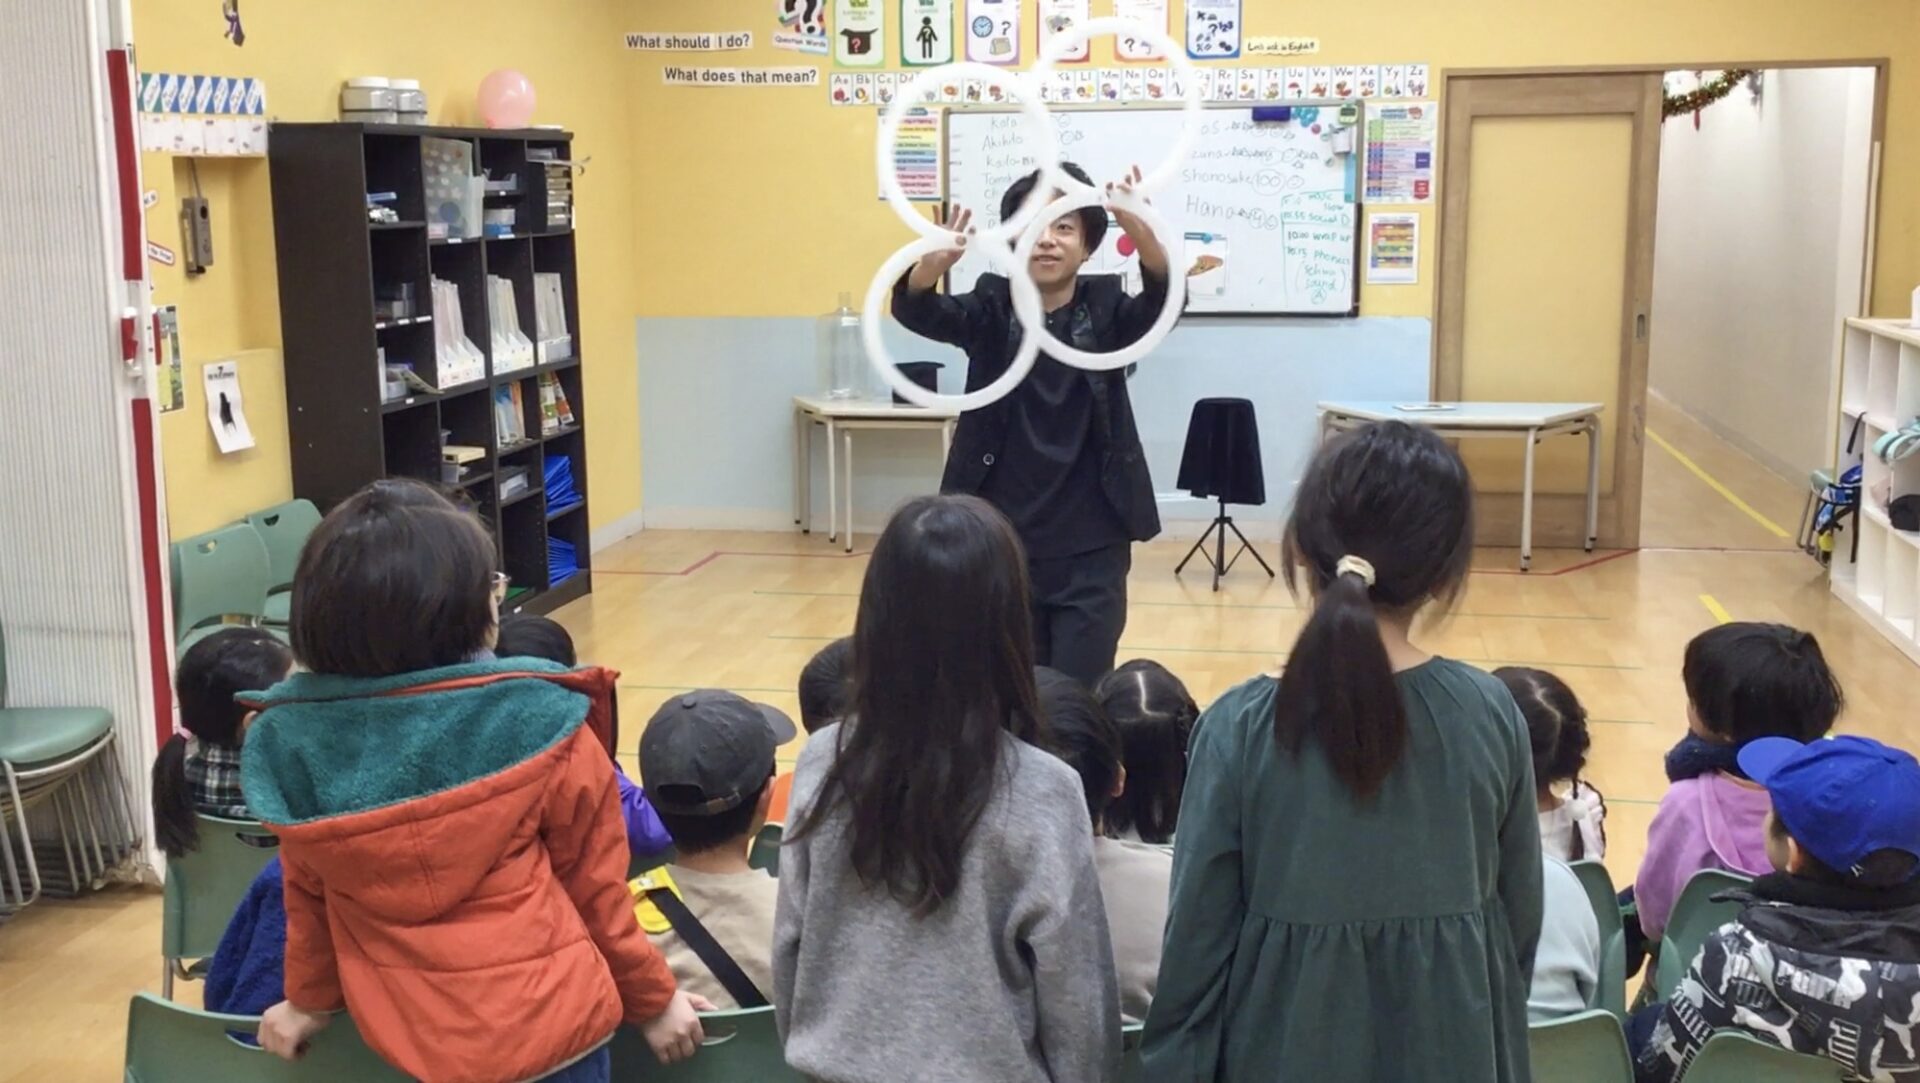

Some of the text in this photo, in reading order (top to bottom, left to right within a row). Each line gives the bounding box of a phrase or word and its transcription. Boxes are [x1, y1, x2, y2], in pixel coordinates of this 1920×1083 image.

[627, 34, 750, 48] What should I do?
[665, 67, 817, 83] What does that mean?
[856, 74, 870, 84] Bb
[1218, 70, 1231, 80] Rr
[1386, 66, 1399, 80] Yy
